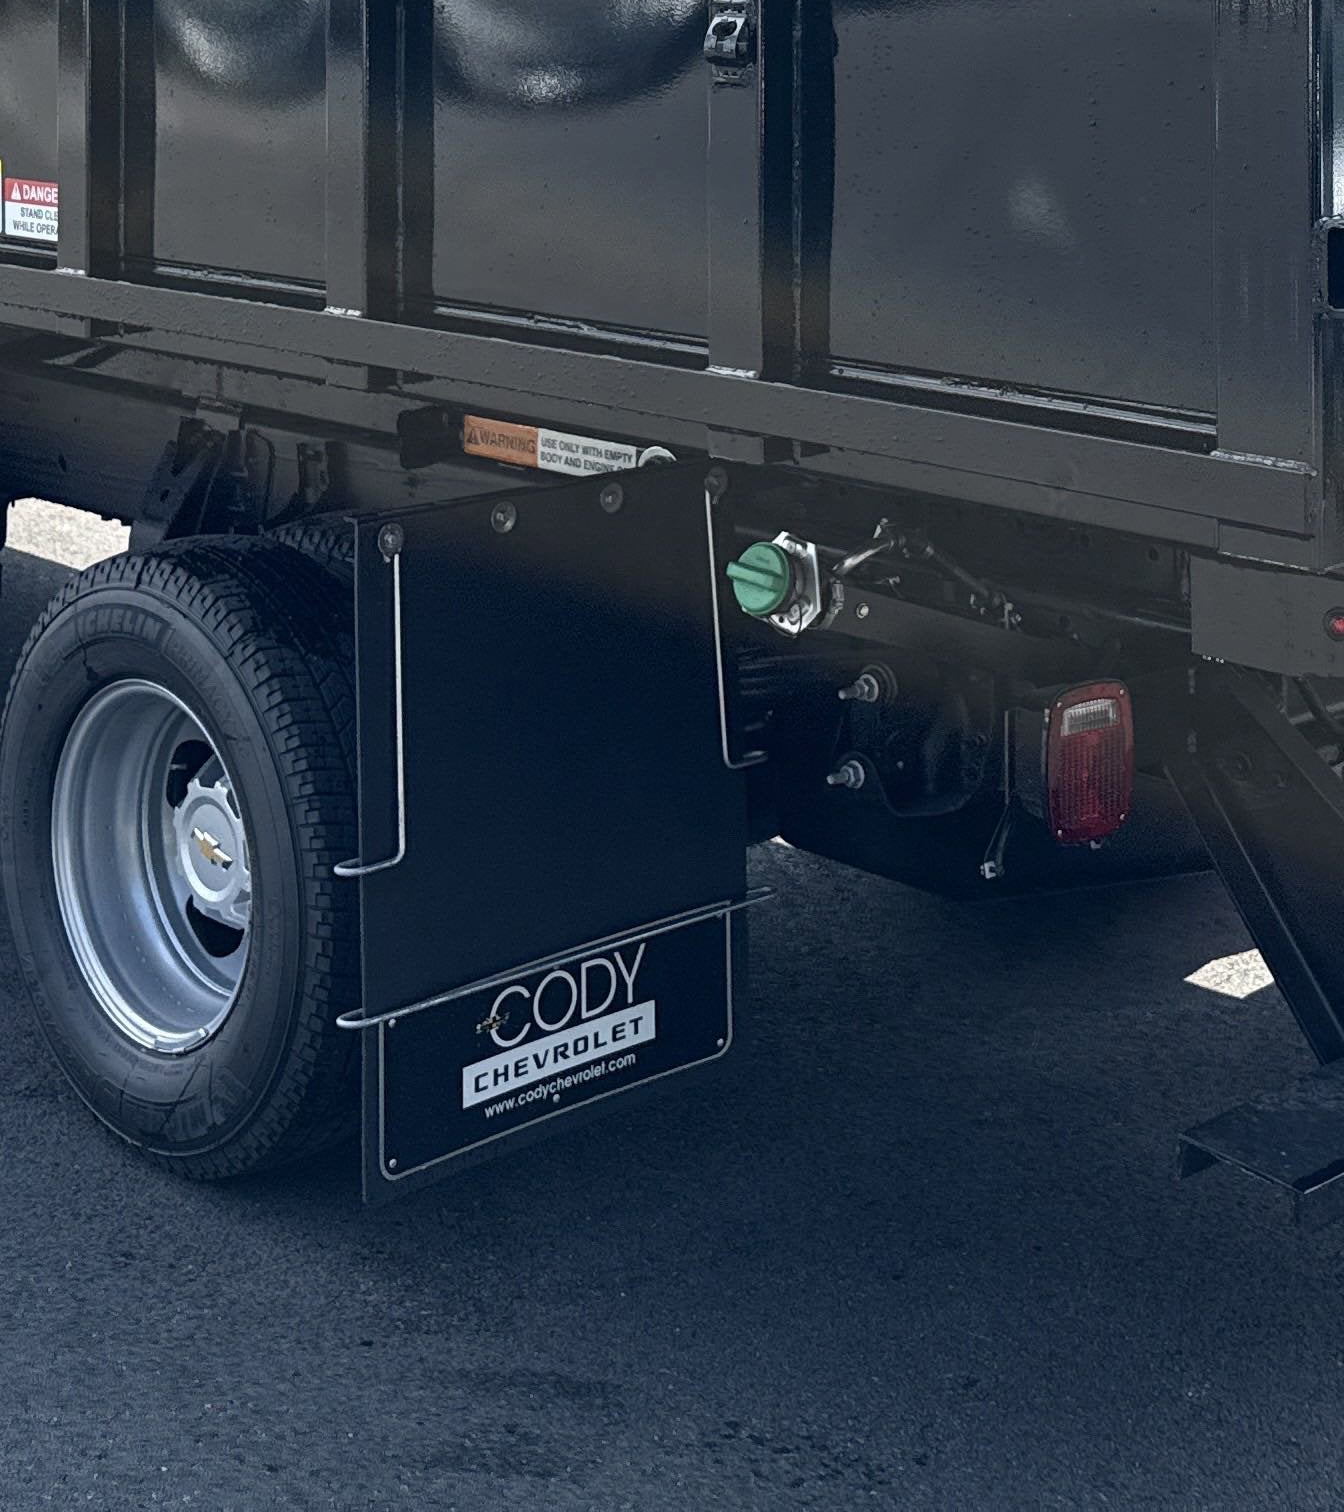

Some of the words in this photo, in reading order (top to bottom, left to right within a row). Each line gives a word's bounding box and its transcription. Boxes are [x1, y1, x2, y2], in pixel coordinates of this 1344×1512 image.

[22, 184, 59, 204] DANGE
[13, 219, 35, 233] WHILE
[20, 207, 44, 220] STAND
[45, 209, 59, 222] CLE
[479, 429, 536, 454] WARNING
[541, 436, 557, 450] USE
[559, 440, 581, 454] ONLY
[581, 445, 603, 458] WITH
[604, 449, 633, 464] EMPTY
[540, 451, 563, 465] BODY
[564, 456, 582, 469] AND
[66, 606, 163, 643] ICHELIN
[489, 943, 647, 1048] CODY
[473, 1016, 645, 1094] CHEVROLET
[484, 1051, 637, 1119] www.codychevrolet.com
